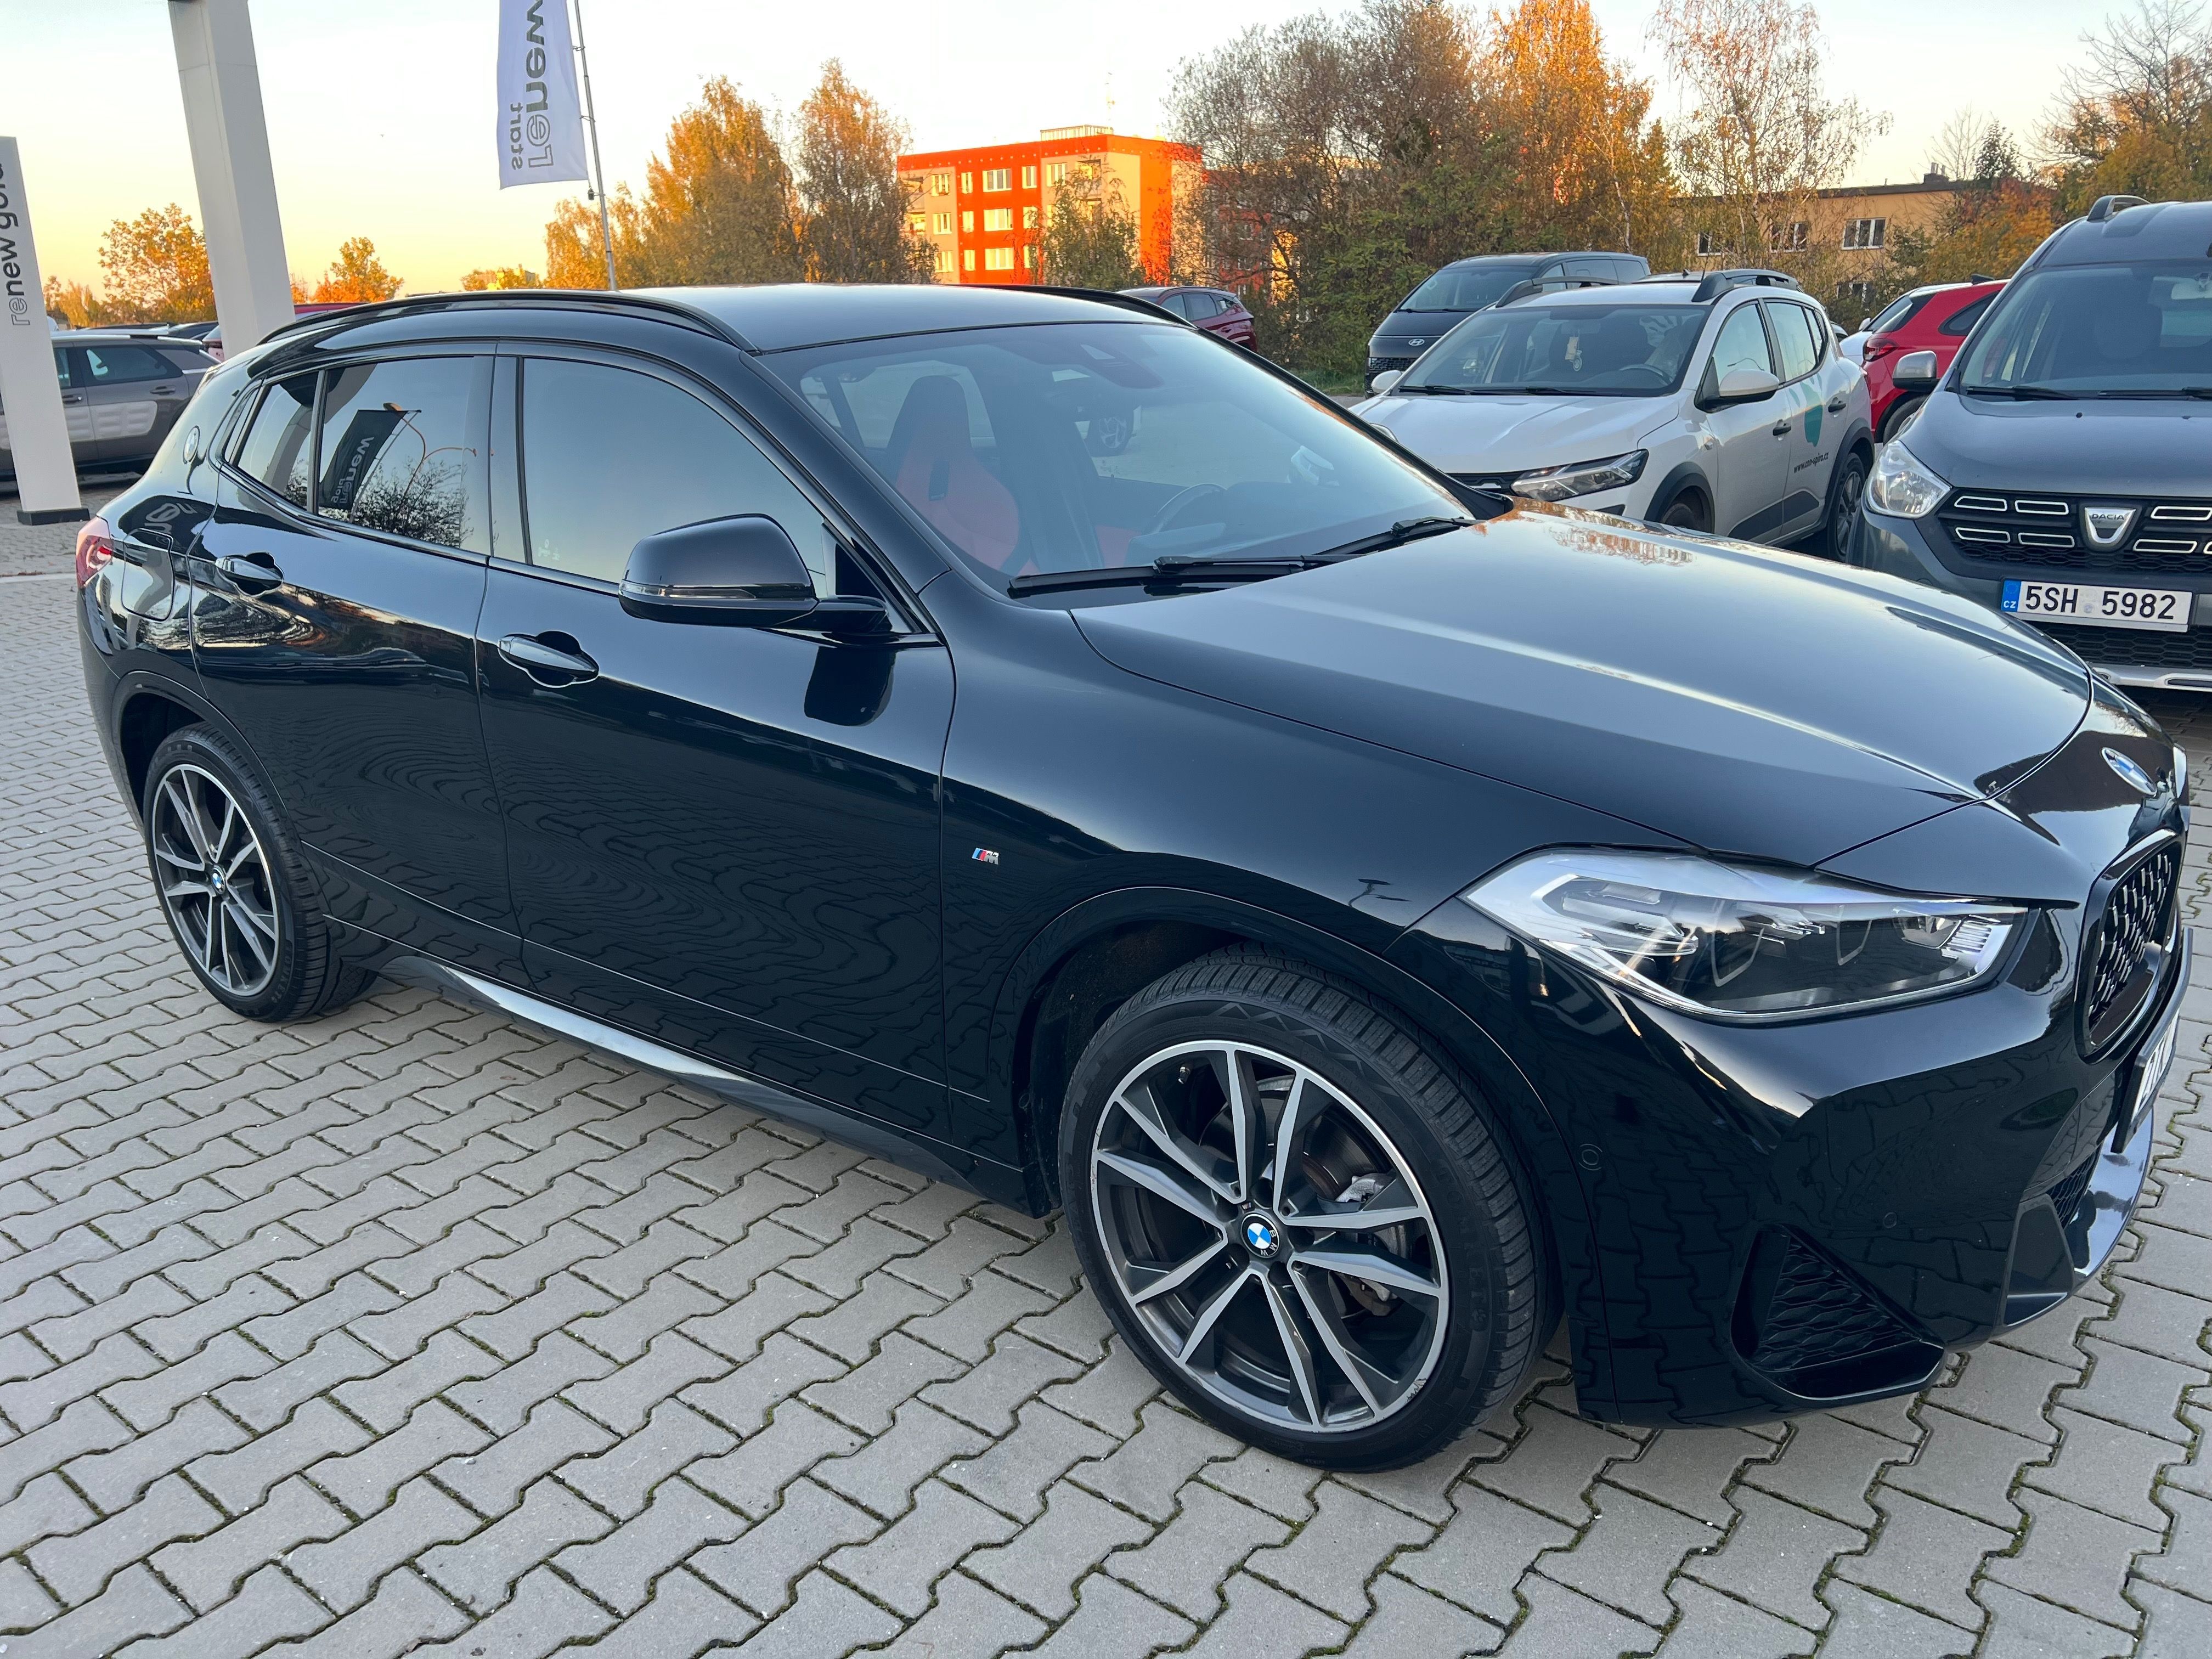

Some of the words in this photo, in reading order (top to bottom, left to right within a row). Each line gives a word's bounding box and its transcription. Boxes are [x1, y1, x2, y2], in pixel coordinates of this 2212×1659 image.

[0, 238, 31, 326] renew
[2003, 600, 2016, 609] CZ
[2025, 585, 2079, 613] 5SH
[2101, 590, 2177, 620] 5982
[1260, 1229, 1278, 1256] BMW
